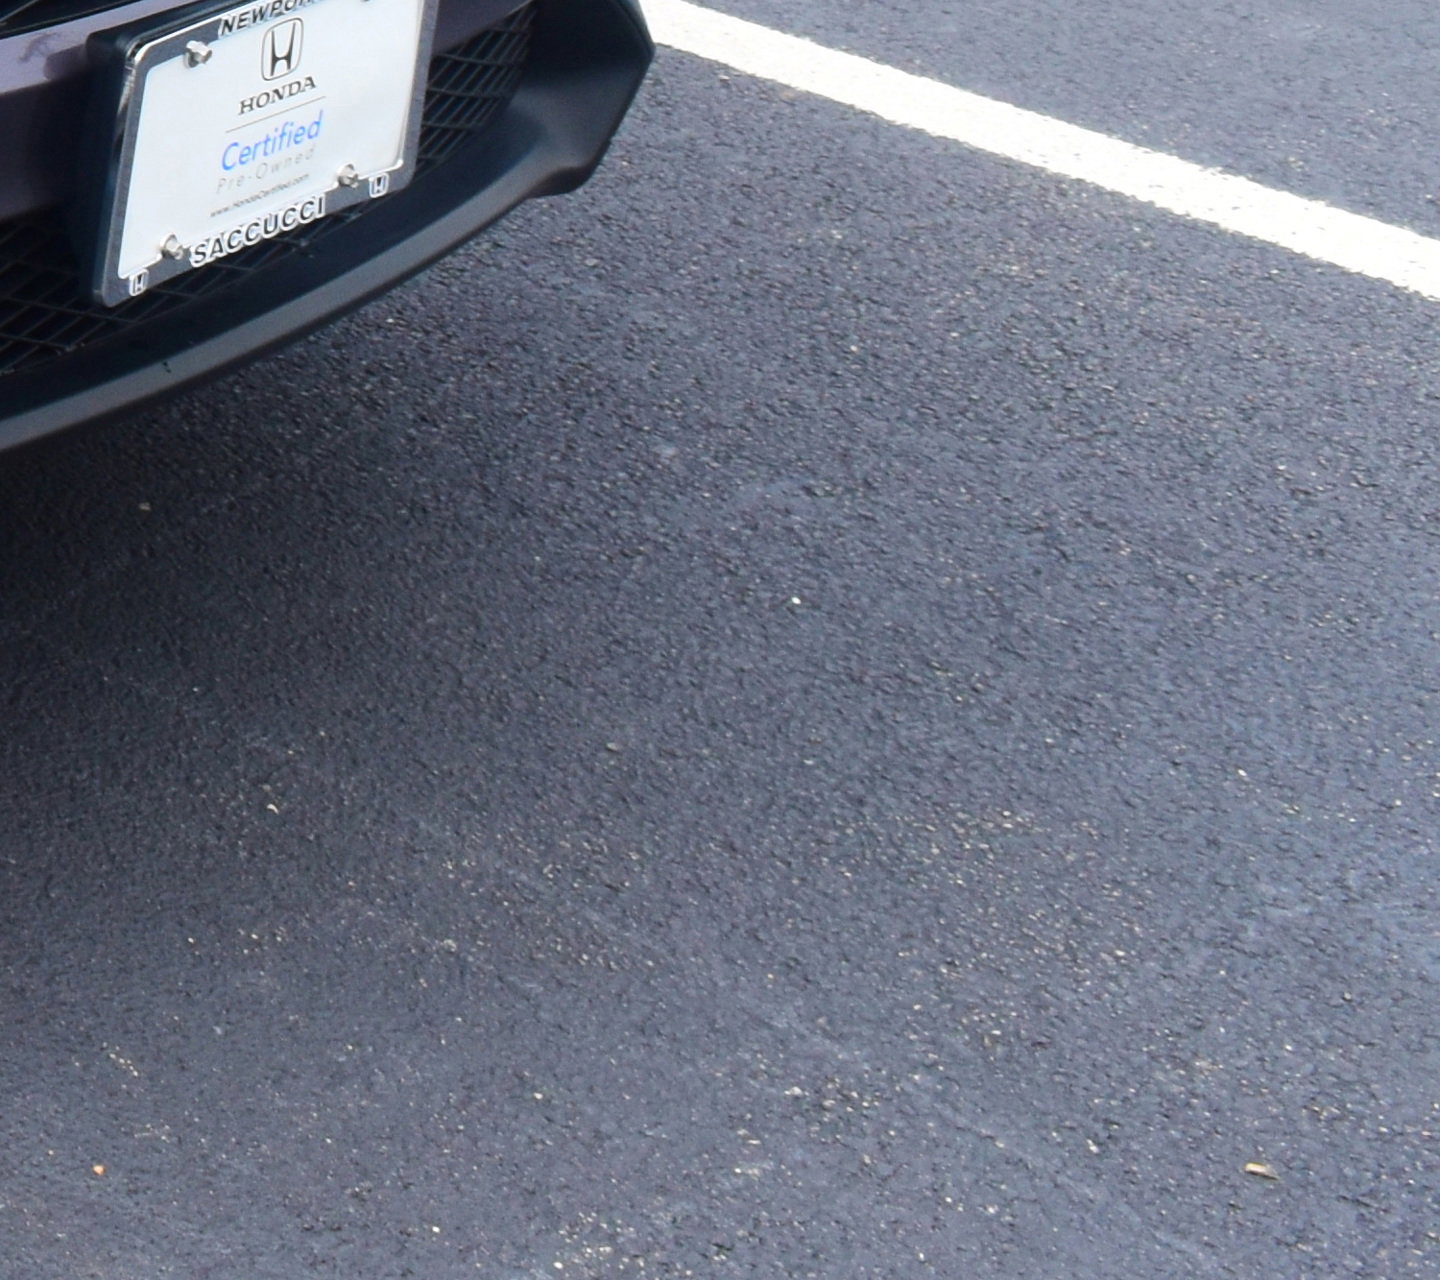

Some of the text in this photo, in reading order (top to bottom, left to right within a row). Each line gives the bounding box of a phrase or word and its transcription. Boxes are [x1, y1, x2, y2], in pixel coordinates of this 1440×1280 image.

[237, 76, 316, 117] HONDA
[221, 109, 323, 171] Certified
[215, 143, 316, 195] Pre-Owned
[191, 194, 325, 266] SACCUCCI
